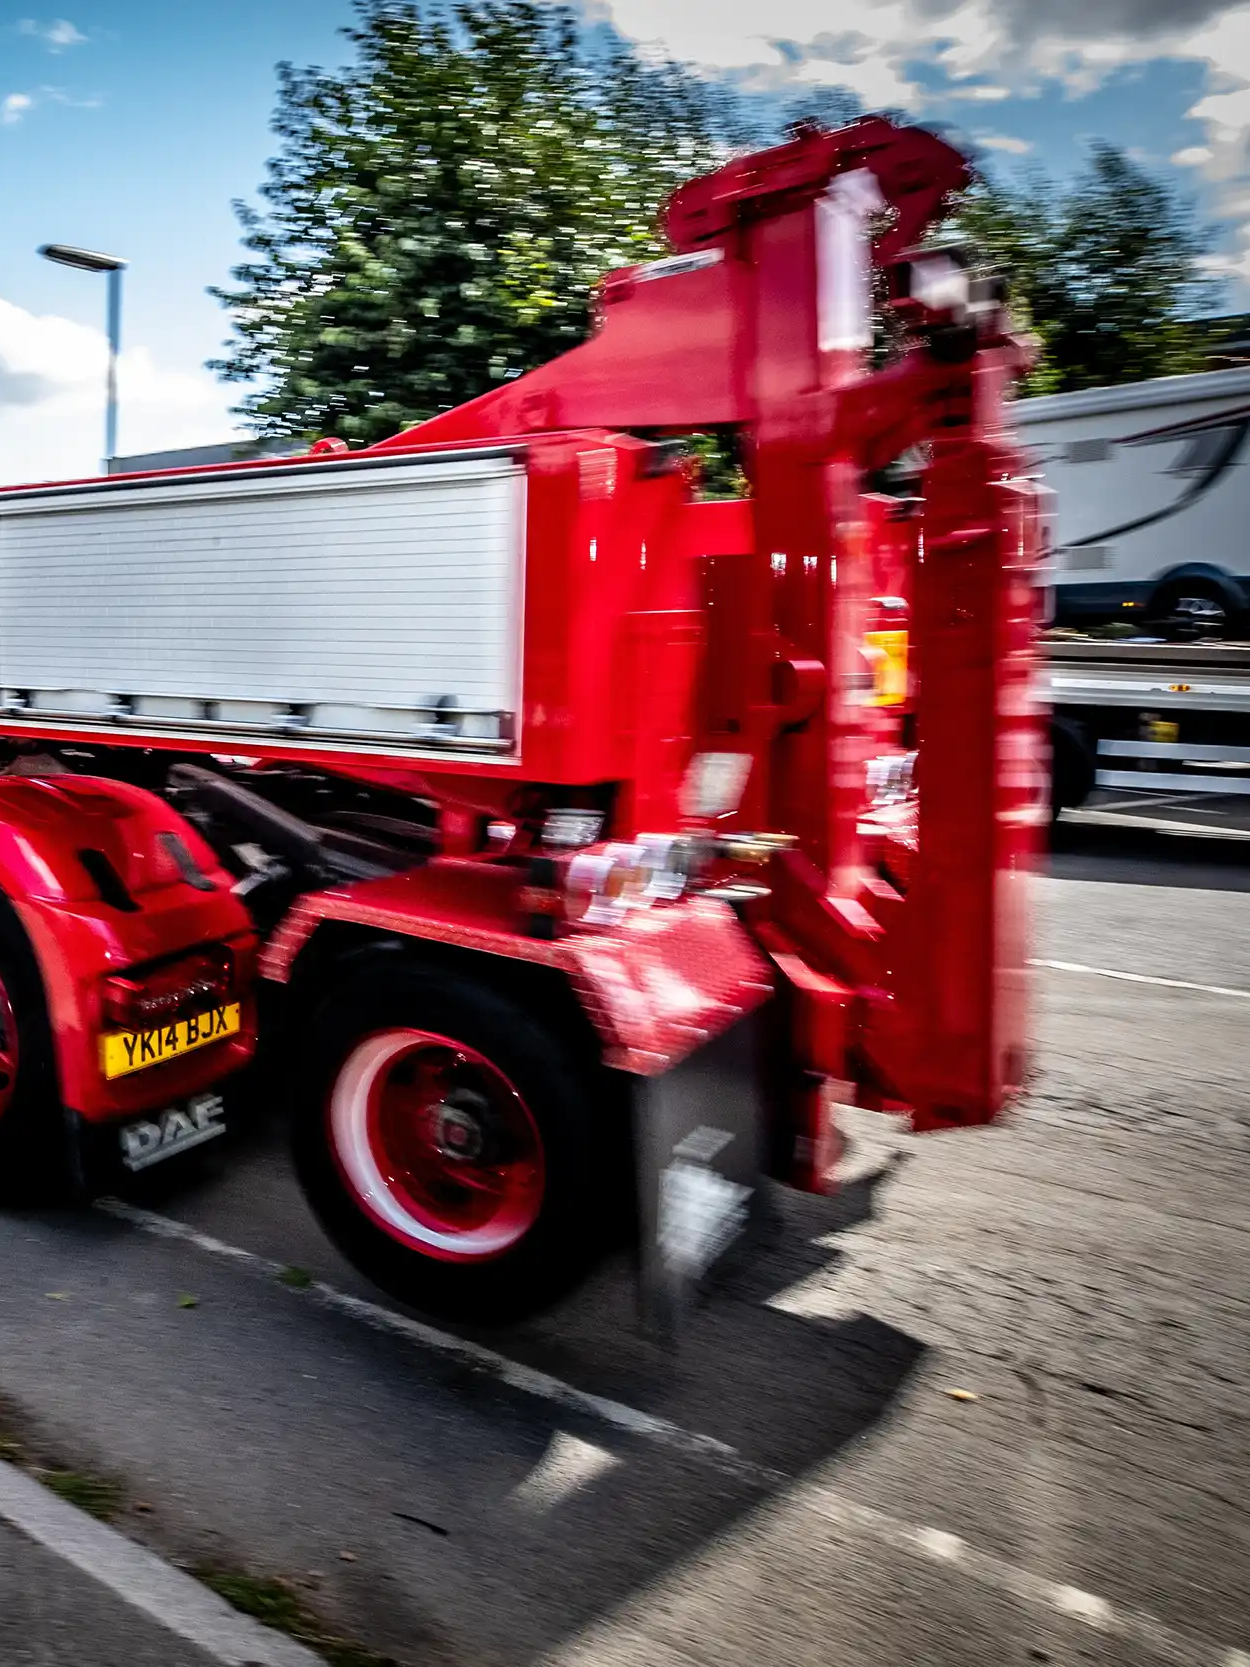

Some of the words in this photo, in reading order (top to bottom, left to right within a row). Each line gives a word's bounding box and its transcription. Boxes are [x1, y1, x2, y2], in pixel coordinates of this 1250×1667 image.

[122, 1024, 179, 1066] YK14
[186, 1006, 228, 1046] BJX
[120, 1094, 225, 1159] DAF
